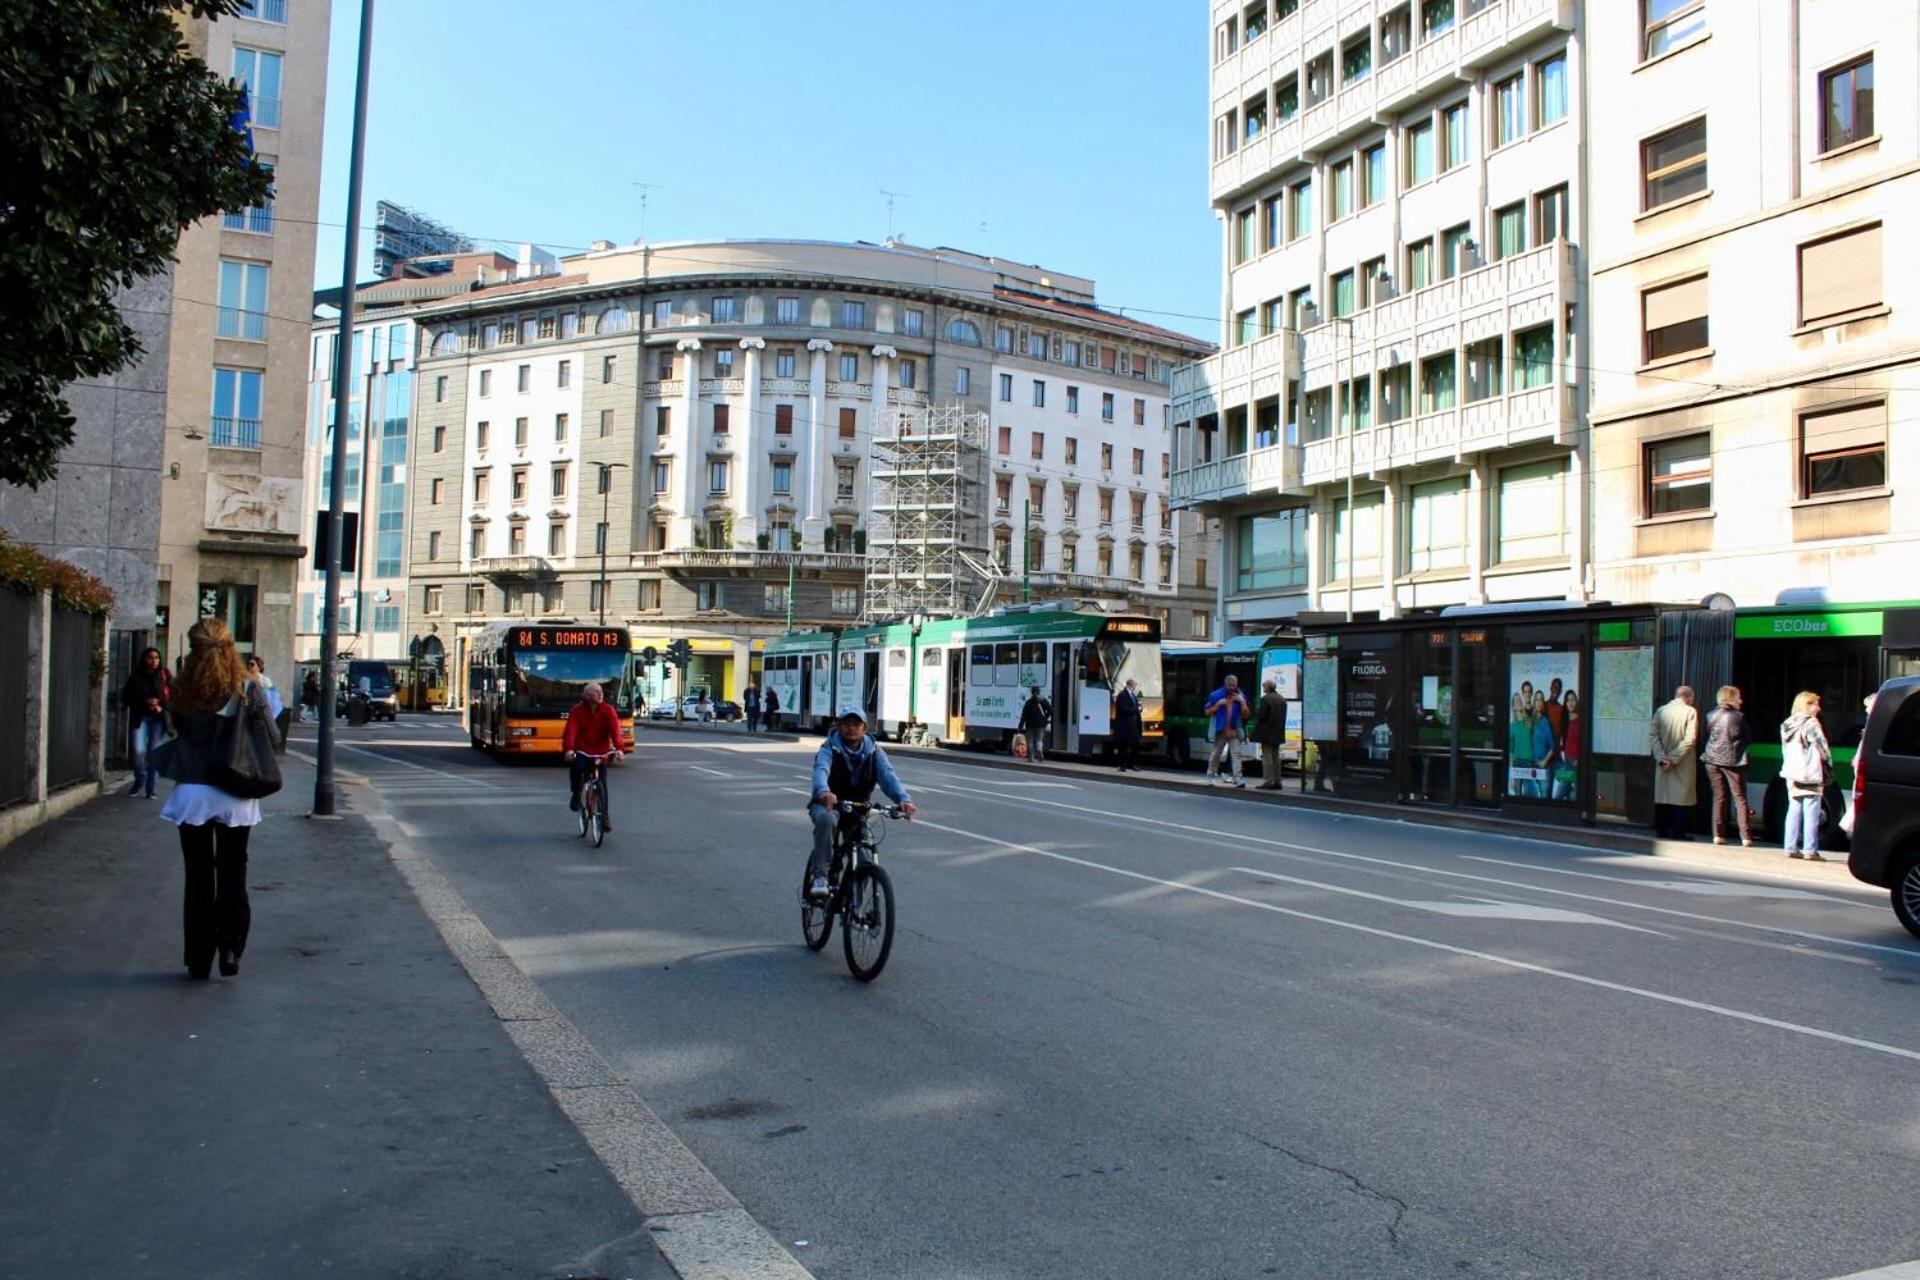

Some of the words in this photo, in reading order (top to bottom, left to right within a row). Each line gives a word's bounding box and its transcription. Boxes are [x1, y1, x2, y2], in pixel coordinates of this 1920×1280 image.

[1774, 619, 1827, 632] ECObus
[520, 632, 532, 646] 84
[540, 632, 551, 645] S.
[556, 632, 599, 645] DONATO
[603, 633, 618, 645] M3
[1352, 666, 1386, 674] FILORGA
